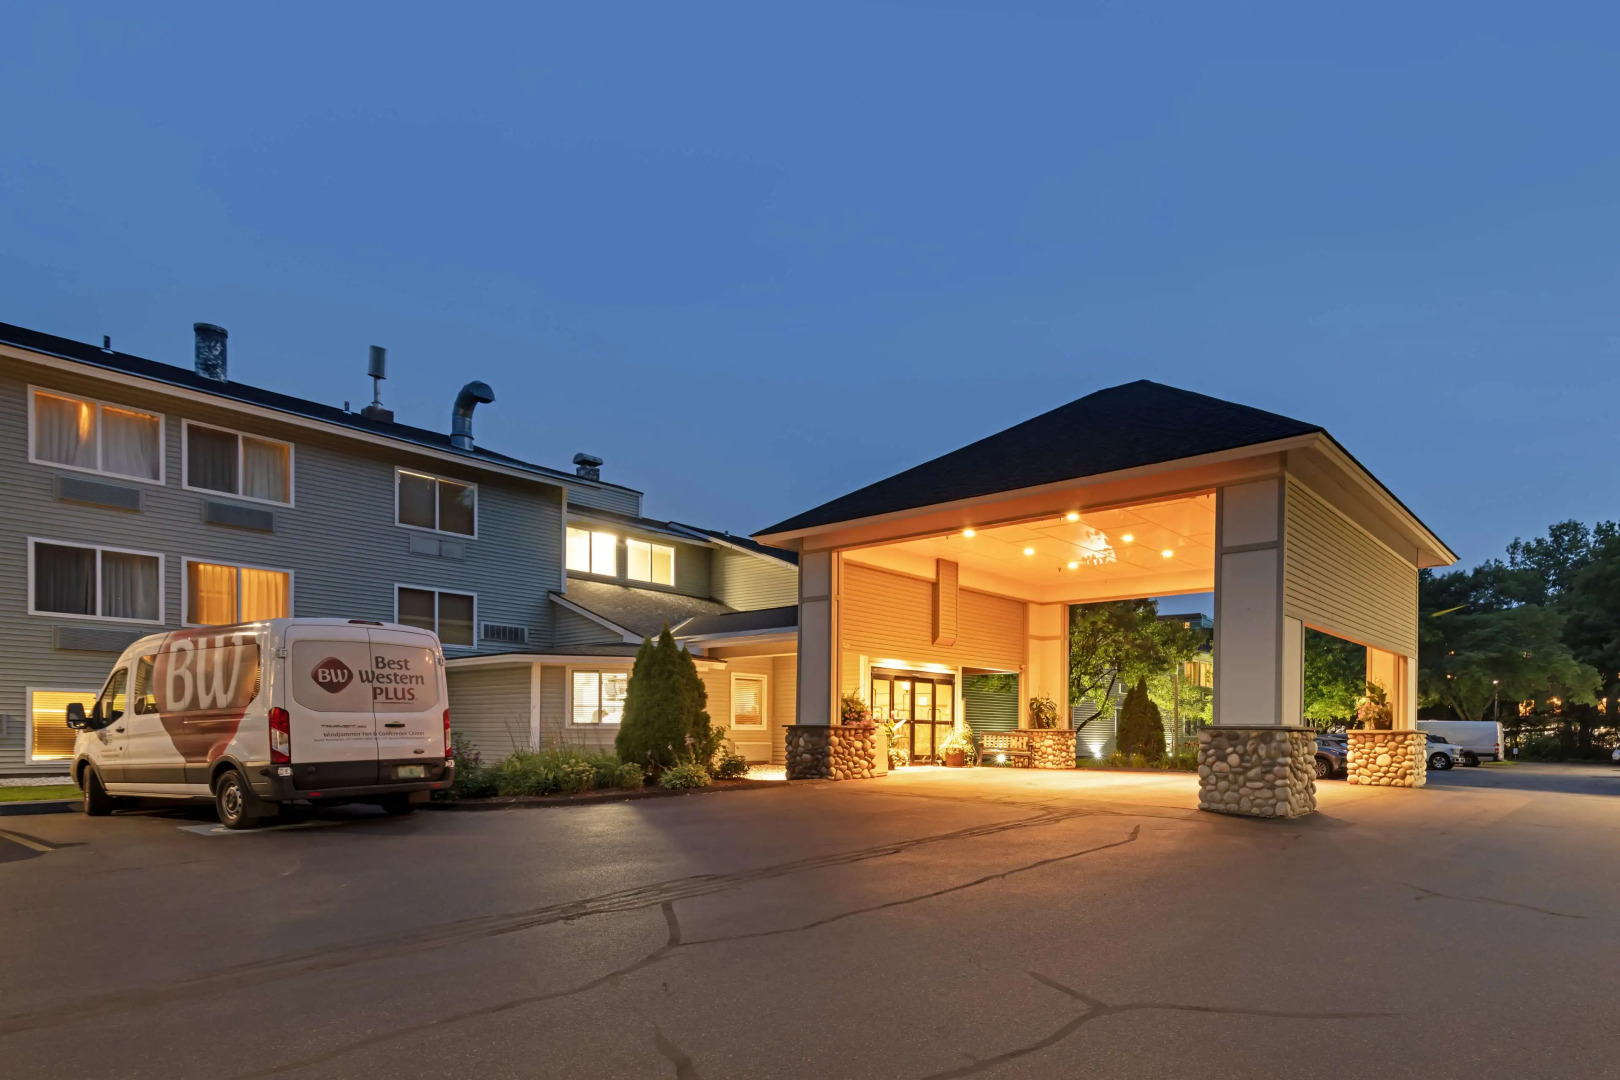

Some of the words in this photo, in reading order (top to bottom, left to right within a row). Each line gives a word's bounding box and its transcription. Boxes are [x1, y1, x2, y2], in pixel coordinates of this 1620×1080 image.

[374, 656, 410, 670] Best
[166, 633, 243, 711] BW
[317, 668, 348, 683] BW
[358, 669, 425, 685] Western
[373, 687, 416, 701] PLUS
